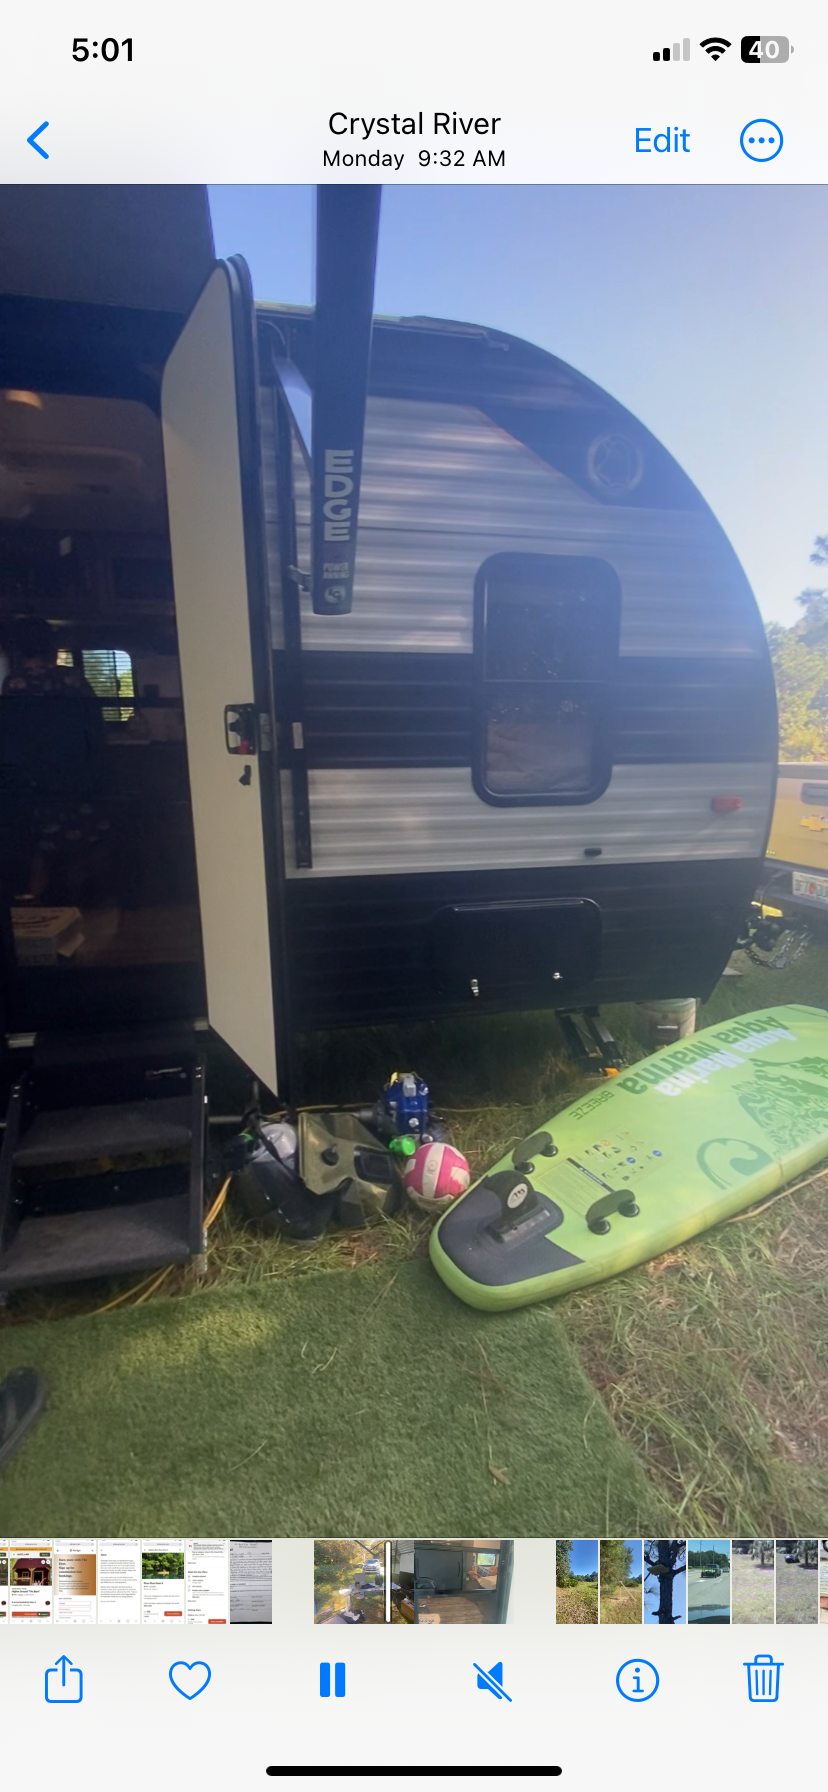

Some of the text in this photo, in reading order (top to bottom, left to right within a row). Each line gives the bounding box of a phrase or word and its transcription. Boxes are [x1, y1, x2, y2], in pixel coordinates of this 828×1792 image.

[71, 38, 133, 63] 5:01
[748, 40, 780, 59] 40
[328, 110, 502, 141] Crystal River
[635, 126, 691, 153] Edit
[323, 149, 506, 171] Monday 9:32 AM
[322, 449, 354, 542] EDGE
[616, 1016, 790, 1095] Aqua Marina
[653, 1048, 746, 1097] Marina
[568, 1089, 615, 1121] BREEZE
